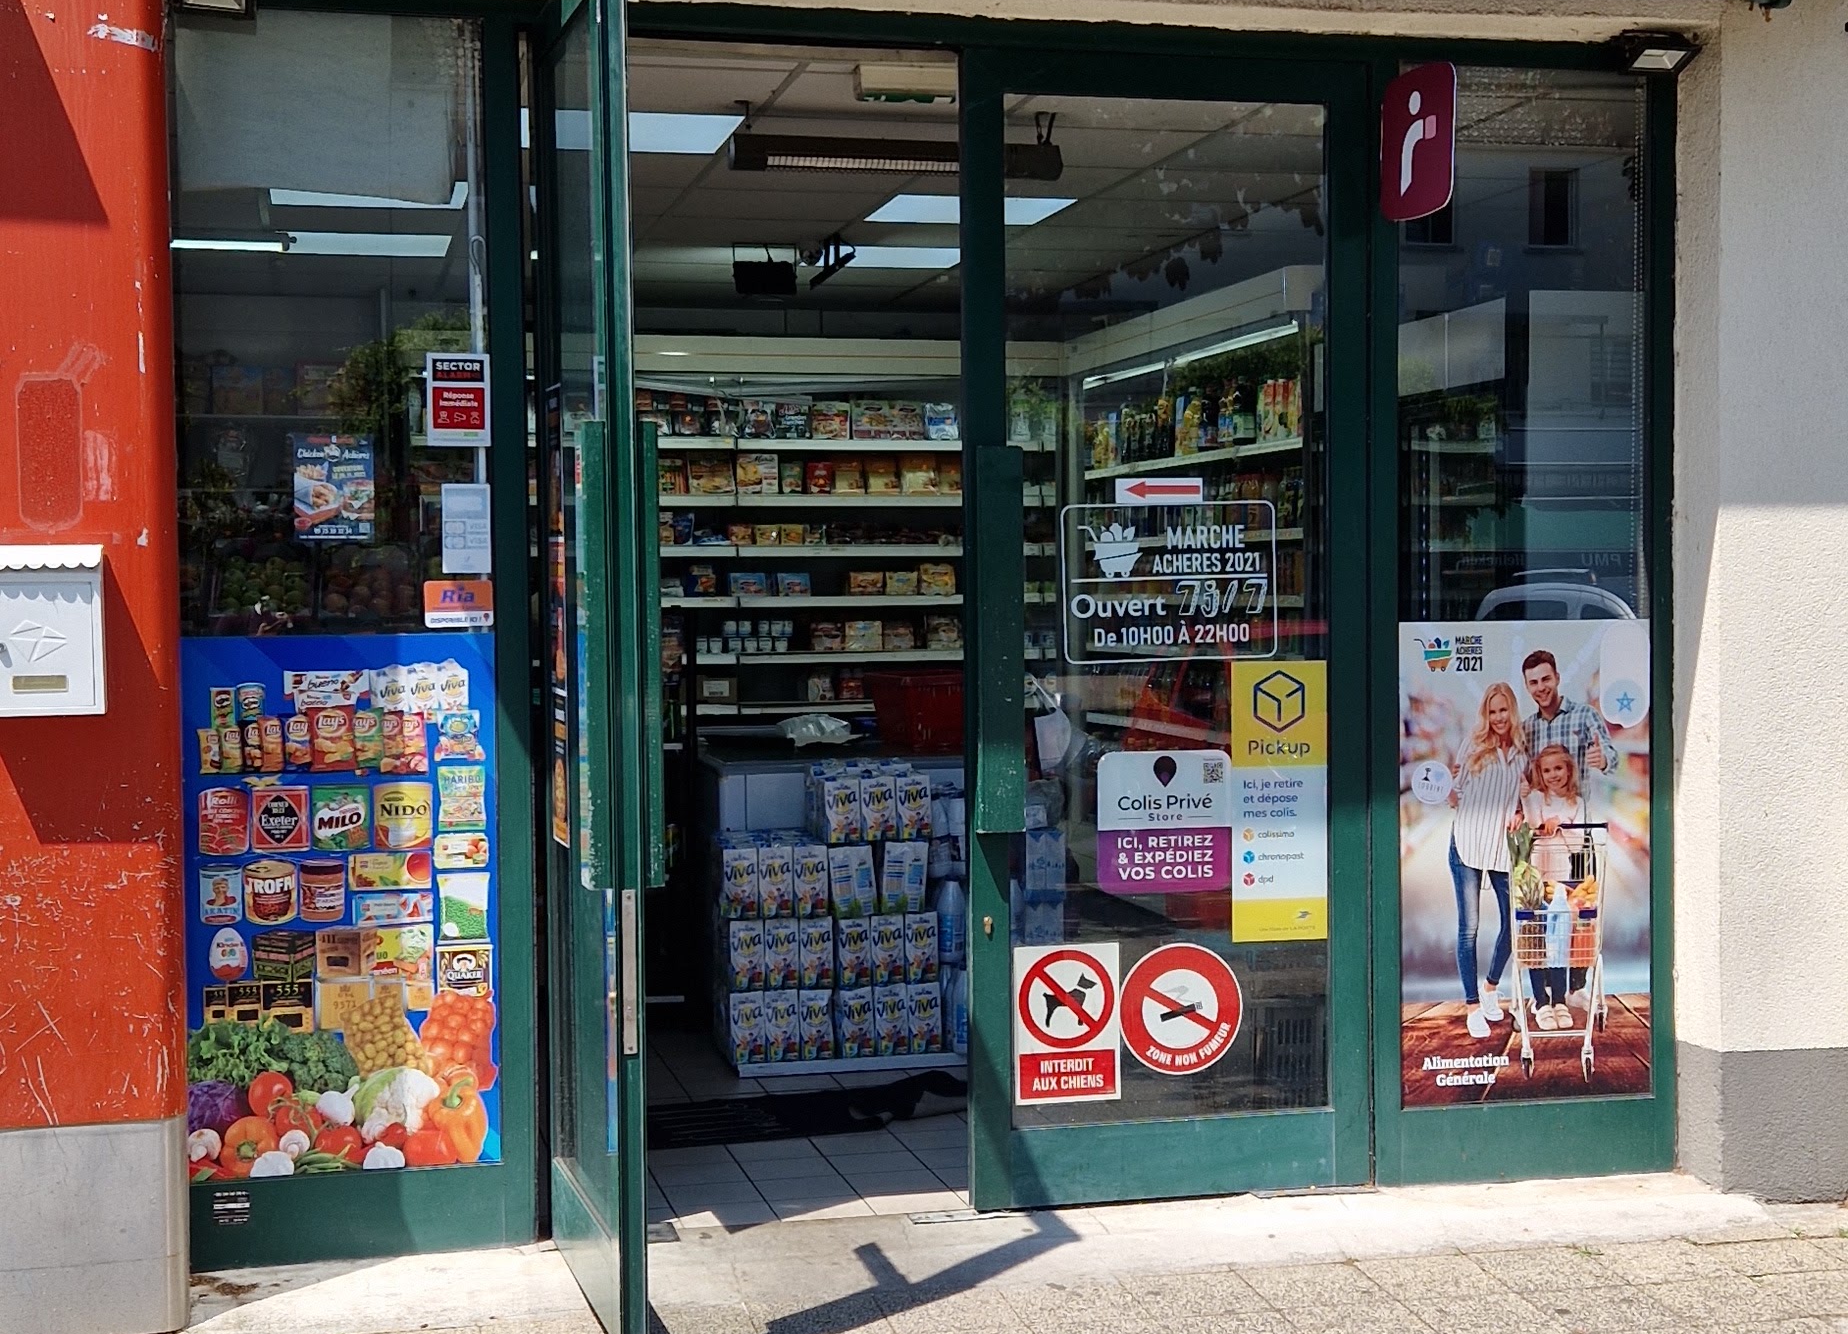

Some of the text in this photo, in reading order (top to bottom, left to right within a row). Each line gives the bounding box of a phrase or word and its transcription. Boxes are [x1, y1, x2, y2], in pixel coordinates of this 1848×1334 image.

[435, 361, 481, 371] SECTOR
[1166, 525, 1245, 550] MARCHE
[1152, 552, 1261, 574] ACHERES 2021
[441, 584, 475, 604] Ria
[1070, 578, 1268, 619] Ouvert 7j/7
[1094, 620, 1250, 647] De 10H00 À 22H00
[1454, 635, 1483, 645] MARCHE
[1455, 646, 1483, 655] ACHERES
[1455, 656, 1483, 672] 2021
[307, 679, 339, 690] bueno
[1248, 739, 1310, 757] Pickup
[444, 775, 481, 784] HARIBO
[1243, 778, 1304, 791] Ici, je retire
[1117, 793, 1213, 811] Colis Privé
[1243, 793, 1298, 805] et dépose
[380, 803, 428, 816] NIDO
[1148, 812, 1183, 822] Store
[1243, 807, 1297, 818] mes colis.
[261, 814, 298, 827] Exeter
[317, 812, 362, 830] MILO
[1258, 830, 1295, 839] colissimo
[1117, 835, 1214, 850] ICI, RETIREZ
[1118, 848, 1214, 865] & EXPÉDIEZ
[1258, 852, 1304, 862] chronopost
[1118, 865, 1214, 881] VOS COLIS
[1258, 875, 1274, 884] dpd
[277, 984, 299, 996] 555
[1145, 1021, 1232, 1066] ZONE NON FUMEUR
[1040, 1057, 1095, 1074] INTERDIT
[1422, 1053, 1510, 1070] Alimentation
[1032, 1074, 1104, 1092] AUX CHIENS
[1436, 1070, 1496, 1086] Générale
